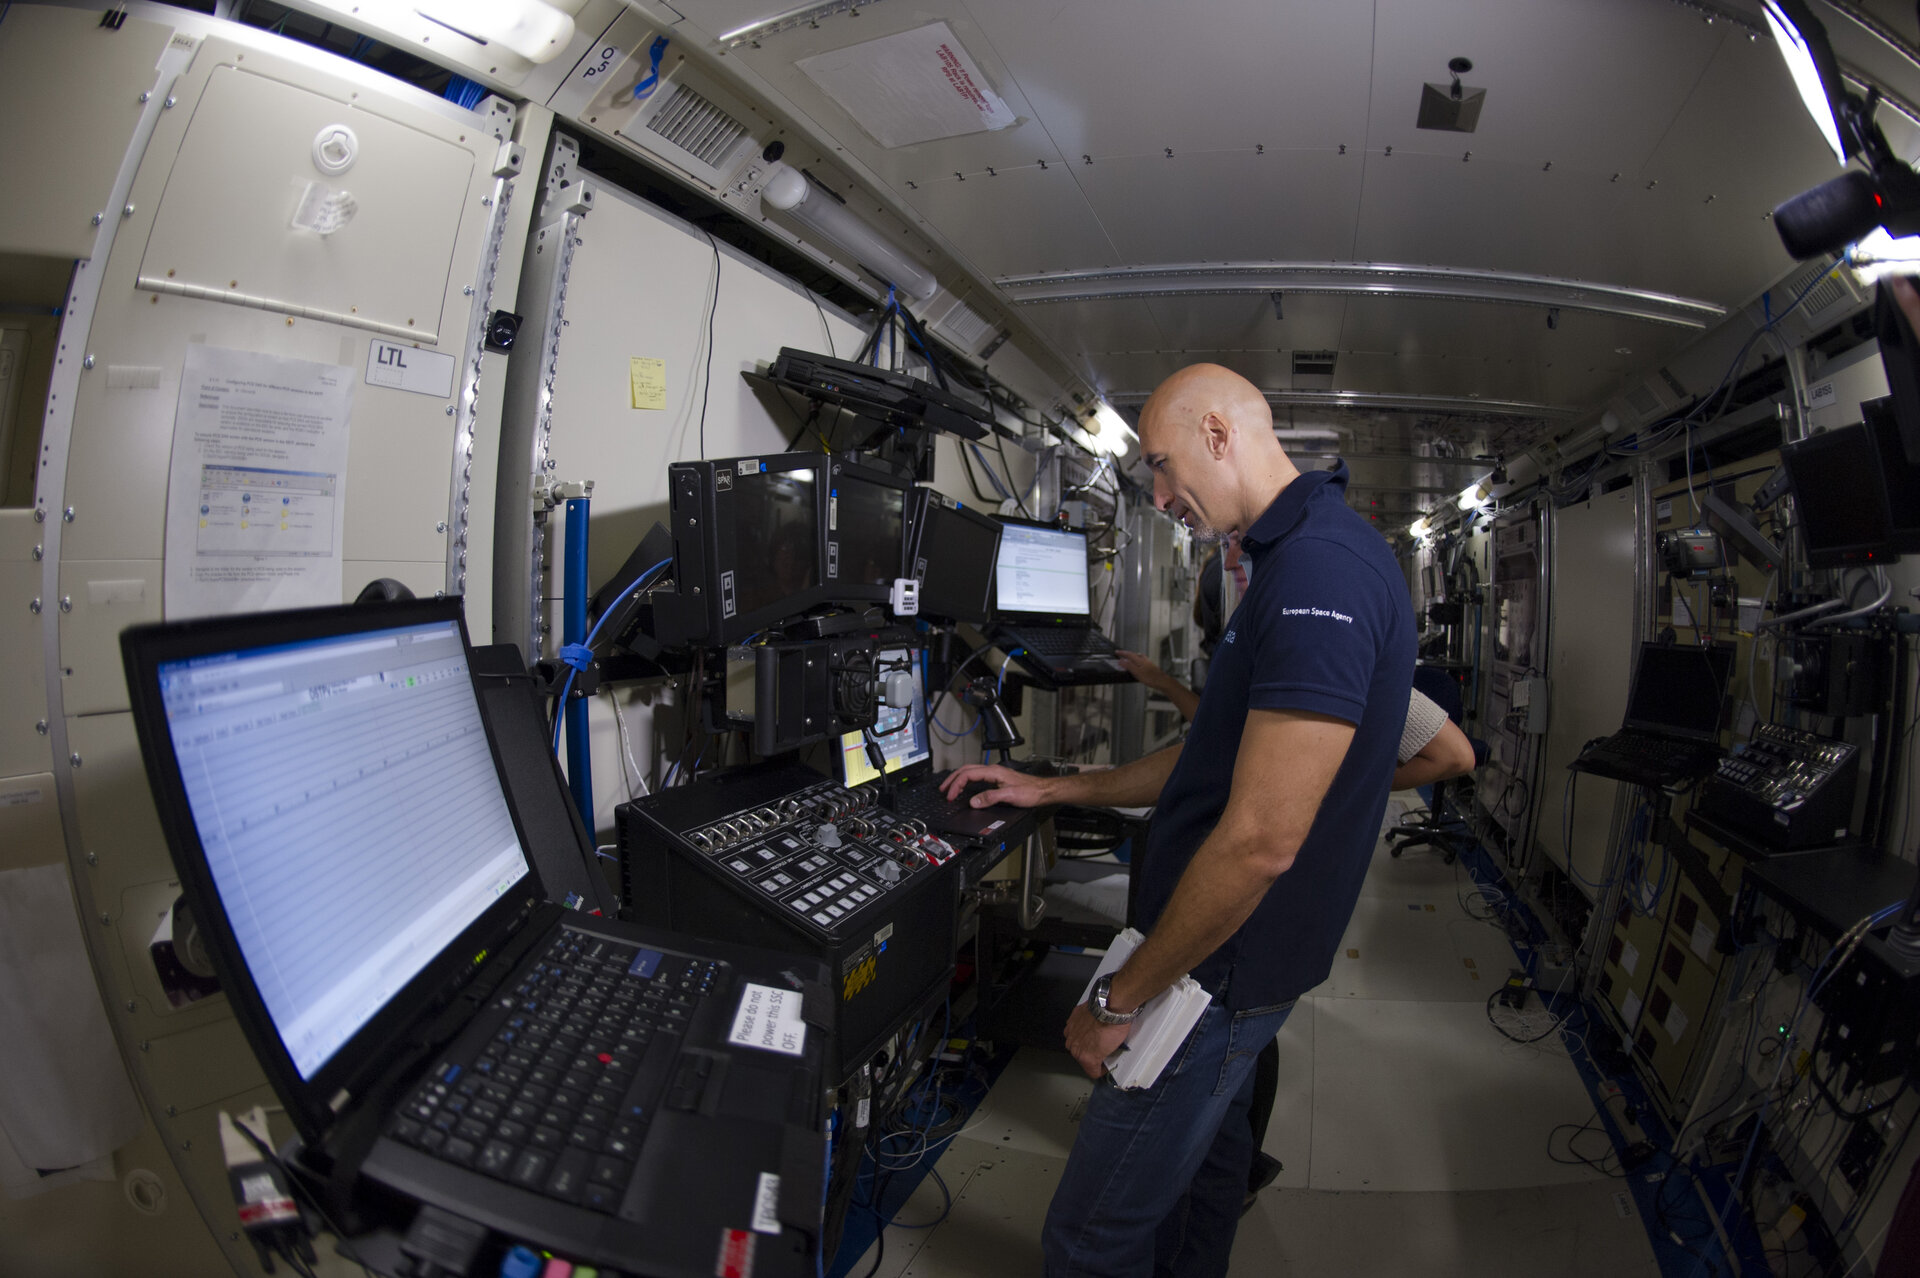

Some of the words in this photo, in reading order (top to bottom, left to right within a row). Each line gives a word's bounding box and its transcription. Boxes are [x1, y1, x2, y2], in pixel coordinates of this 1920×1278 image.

[377, 346, 407, 368] LTL
[1282, 607, 1310, 616] European
[1310, 607, 1330, 617] Space
[1331, 609, 1353, 624] Agency
[750, 989, 762, 1003] not
[770, 989, 783, 1004] SSC
[746, 1003, 759, 1015] do
[766, 1003, 780, 1018] this
[735, 1014, 755, 1042] Please
[760, 1019, 777, 1046] power
